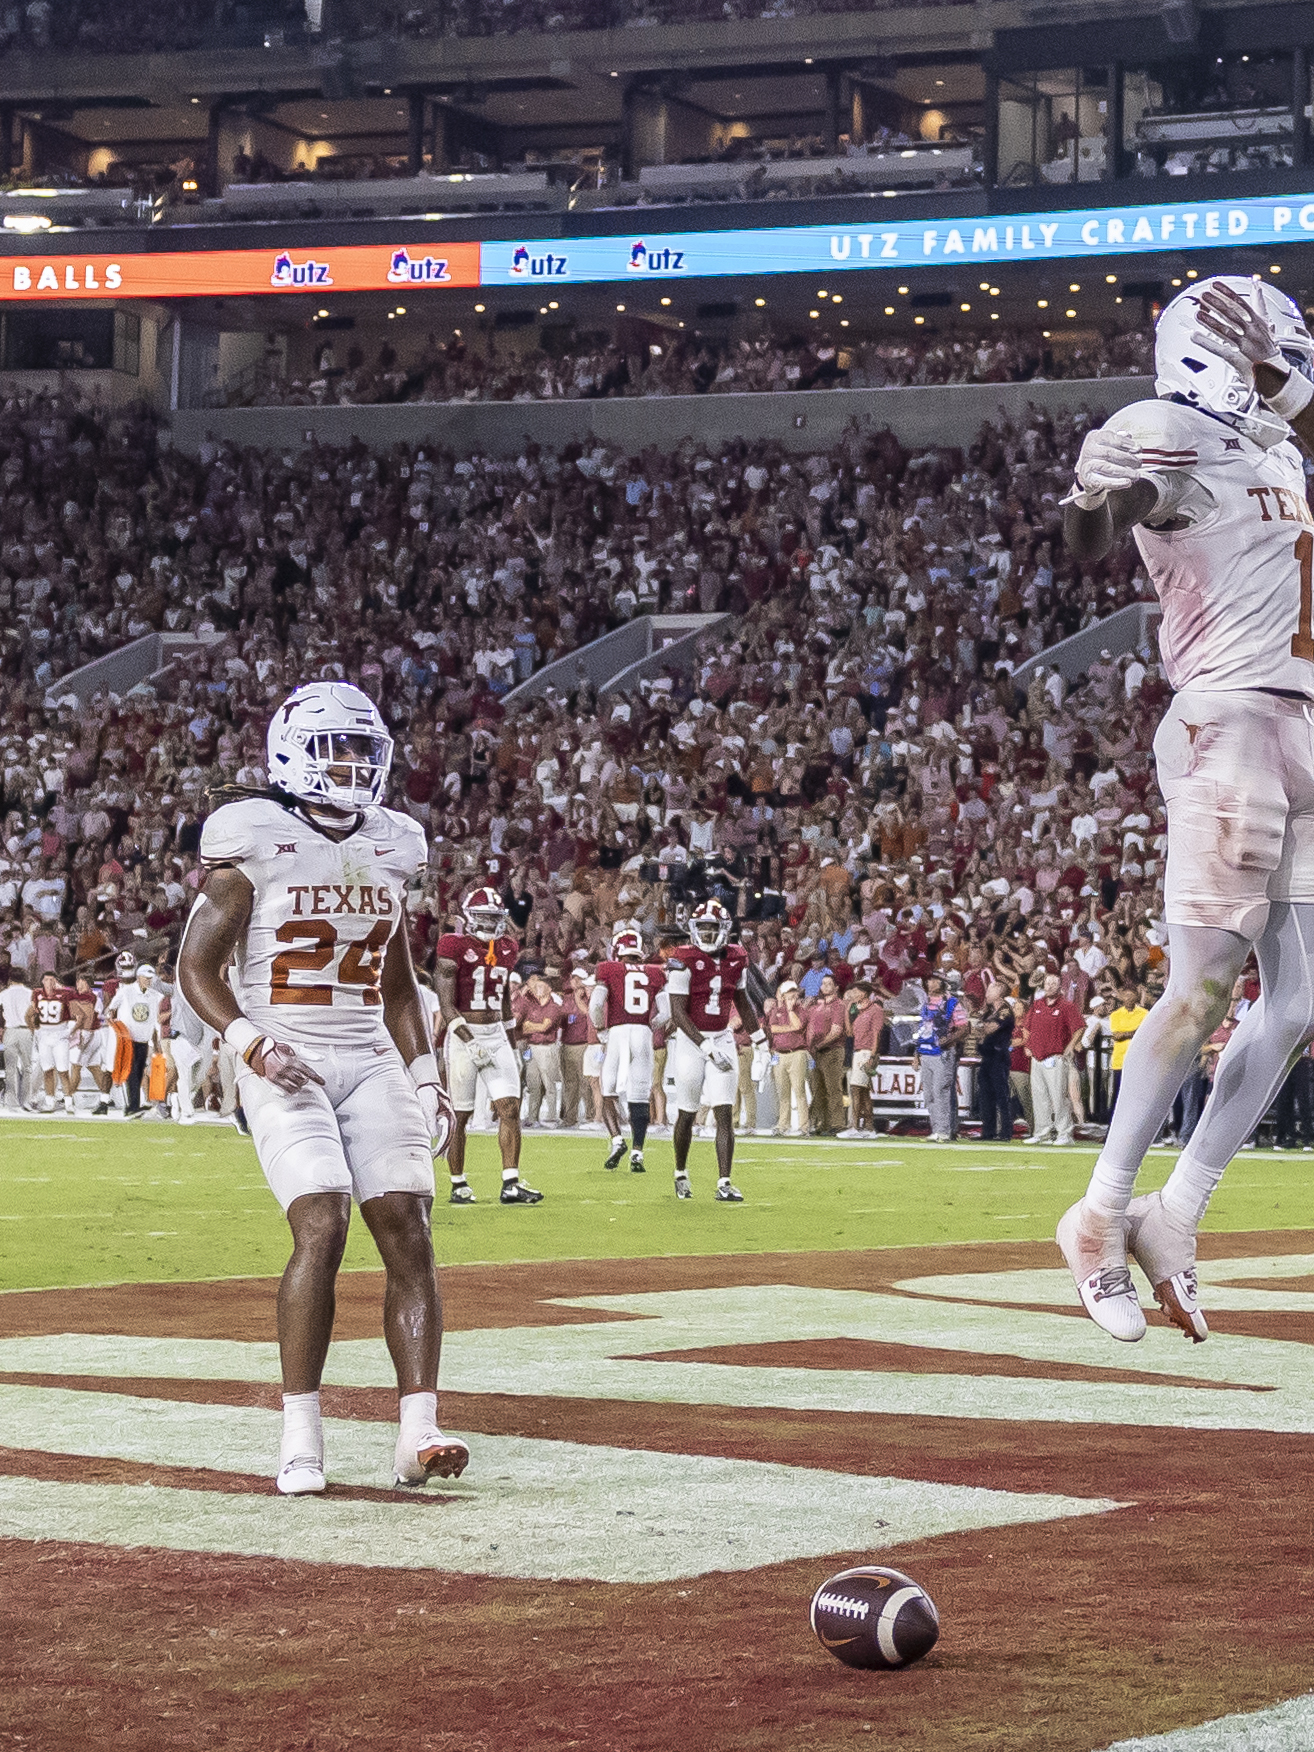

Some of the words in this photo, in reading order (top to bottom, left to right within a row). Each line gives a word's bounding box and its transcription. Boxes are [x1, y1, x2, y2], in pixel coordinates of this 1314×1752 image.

[830, 233, 899, 260] UTZ
[922, 223, 1058, 255] FAMILY
[1081, 210, 1249, 245] CRAFTED
[13, 264, 123, 291] BALLS
[287, 886, 393, 915] TEXAS
[270, 919, 393, 1006] 24
[470, 965, 508, 1010] 13
[624, 971, 650, 1014] 6
[705, 976, 722, 1015] 1
